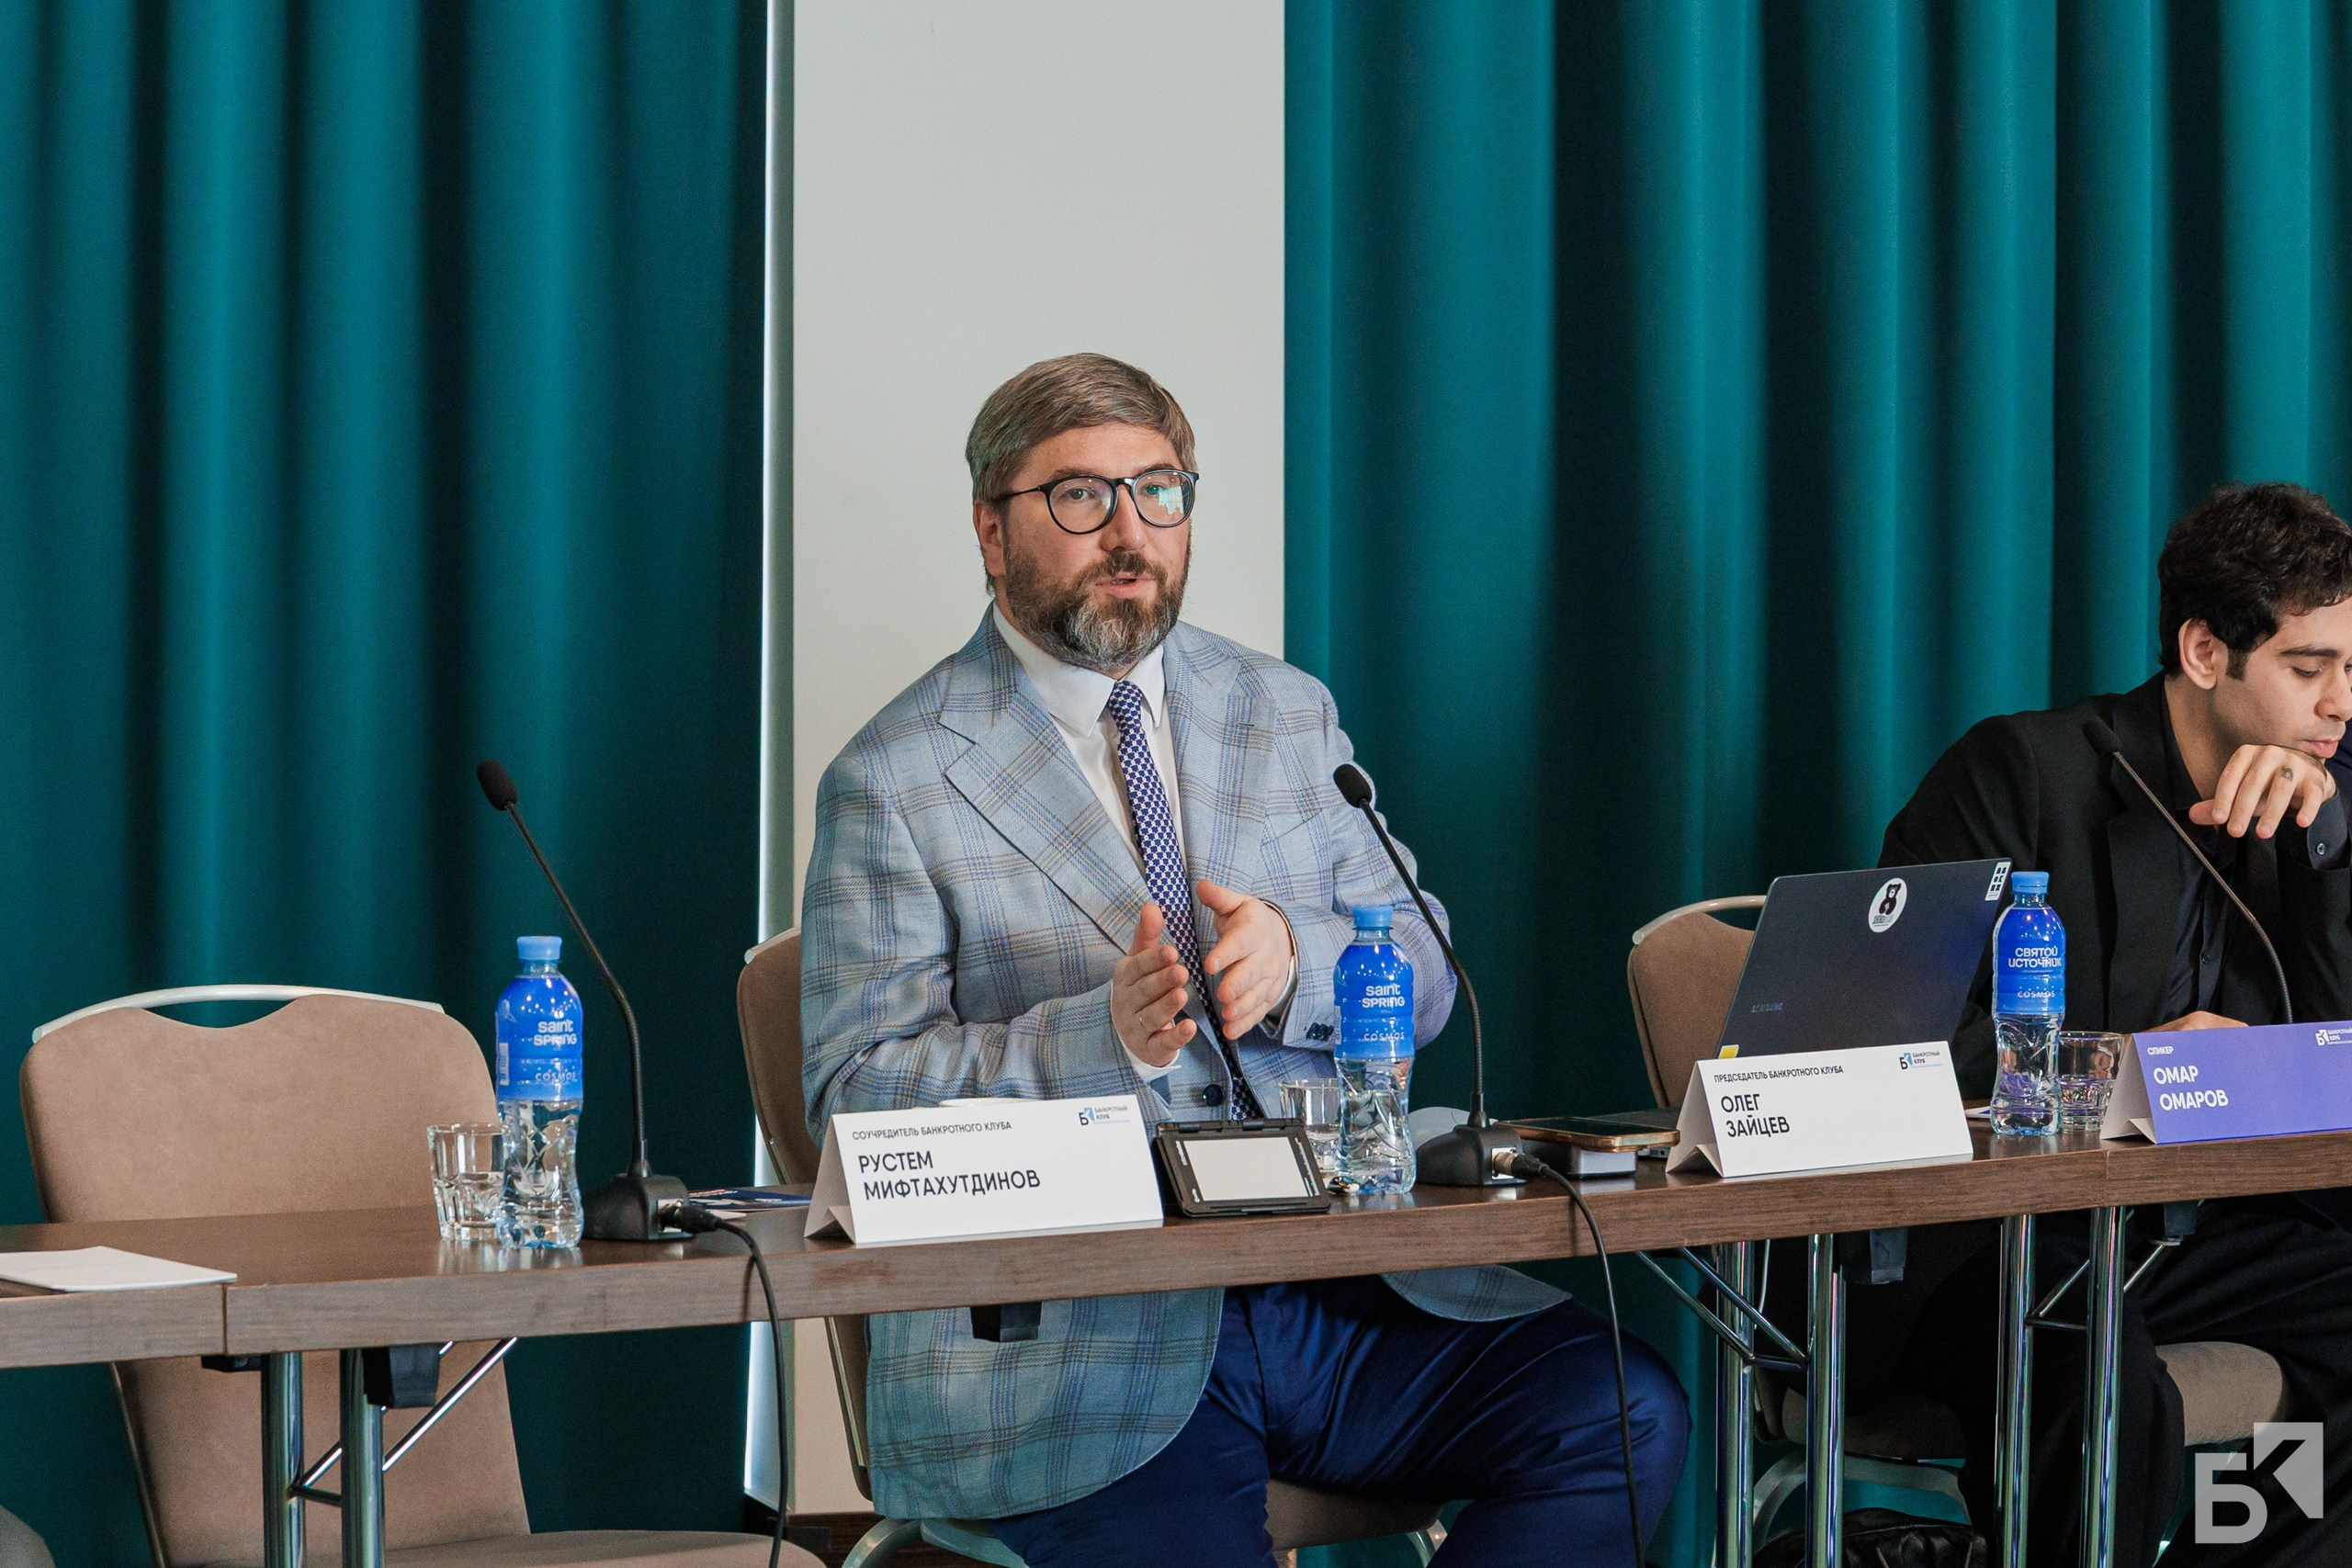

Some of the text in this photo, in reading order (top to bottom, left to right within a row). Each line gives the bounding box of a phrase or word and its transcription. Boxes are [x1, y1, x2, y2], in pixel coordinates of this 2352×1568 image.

[2015, 945, 2058, 957] СВЯТОЙ
[2147, 1046, 2174, 1055] СПИКЕР
[1713, 1066, 1844, 1083] ПРЕДСЕДАТЕЛЬ БАНКРОТНОГО КЛУБА
[2153, 1065, 2199, 1085] ОМАР
[1721, 1093, 1760, 1113] ОЛЕГ
[2159, 1089, 2229, 1111] ОМАРОВ
[852, 1120, 1012, 1141] СОУЧРЕДИТЕЛЬ БАНКРОТНОГО КЛУБА
[1725, 1114, 1791, 1138] ЗАЙЦЕВ
[858, 1150, 933, 1174] РУСТЕМ
[864, 1169, 1041, 1201] МИФТАХУТДИНОВ
